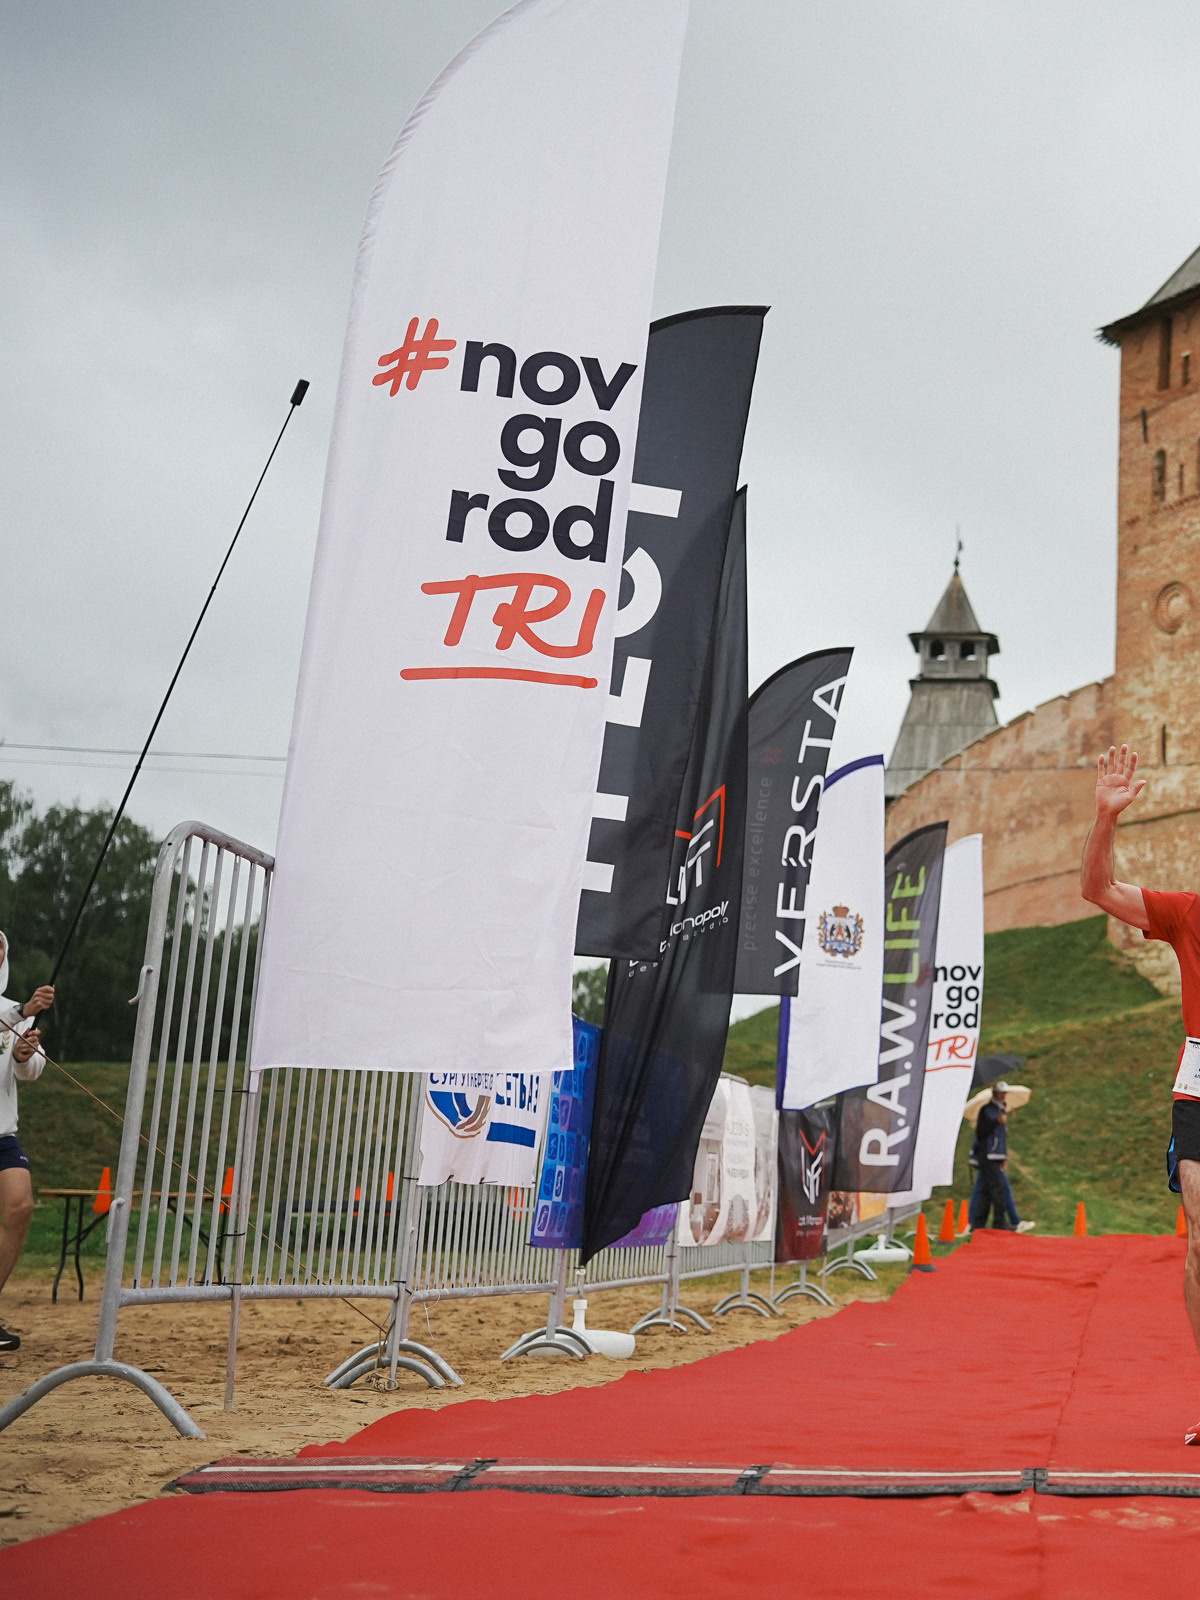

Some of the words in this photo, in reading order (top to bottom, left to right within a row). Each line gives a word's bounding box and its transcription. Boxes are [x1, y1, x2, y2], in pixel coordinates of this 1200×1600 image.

[372, 316, 638, 411] #nov
[497, 413, 620, 492] go
[445, 479, 615, 563] rod
[421, 572, 606, 658] TRI
[747, 777, 772, 877] excellence
[774, 675, 847, 977] VERSTA
[670, 900, 729, 936] onopoly
[743, 884, 758, 951] precise
[883, 865, 926, 984] LIFE
[933, 964, 982, 982] nov
[946, 984, 980, 1009] go
[928, 1036, 977, 1061] TRI
[934, 1003, 979, 1028] rod
[859, 998, 917, 1167] R.A.W.
